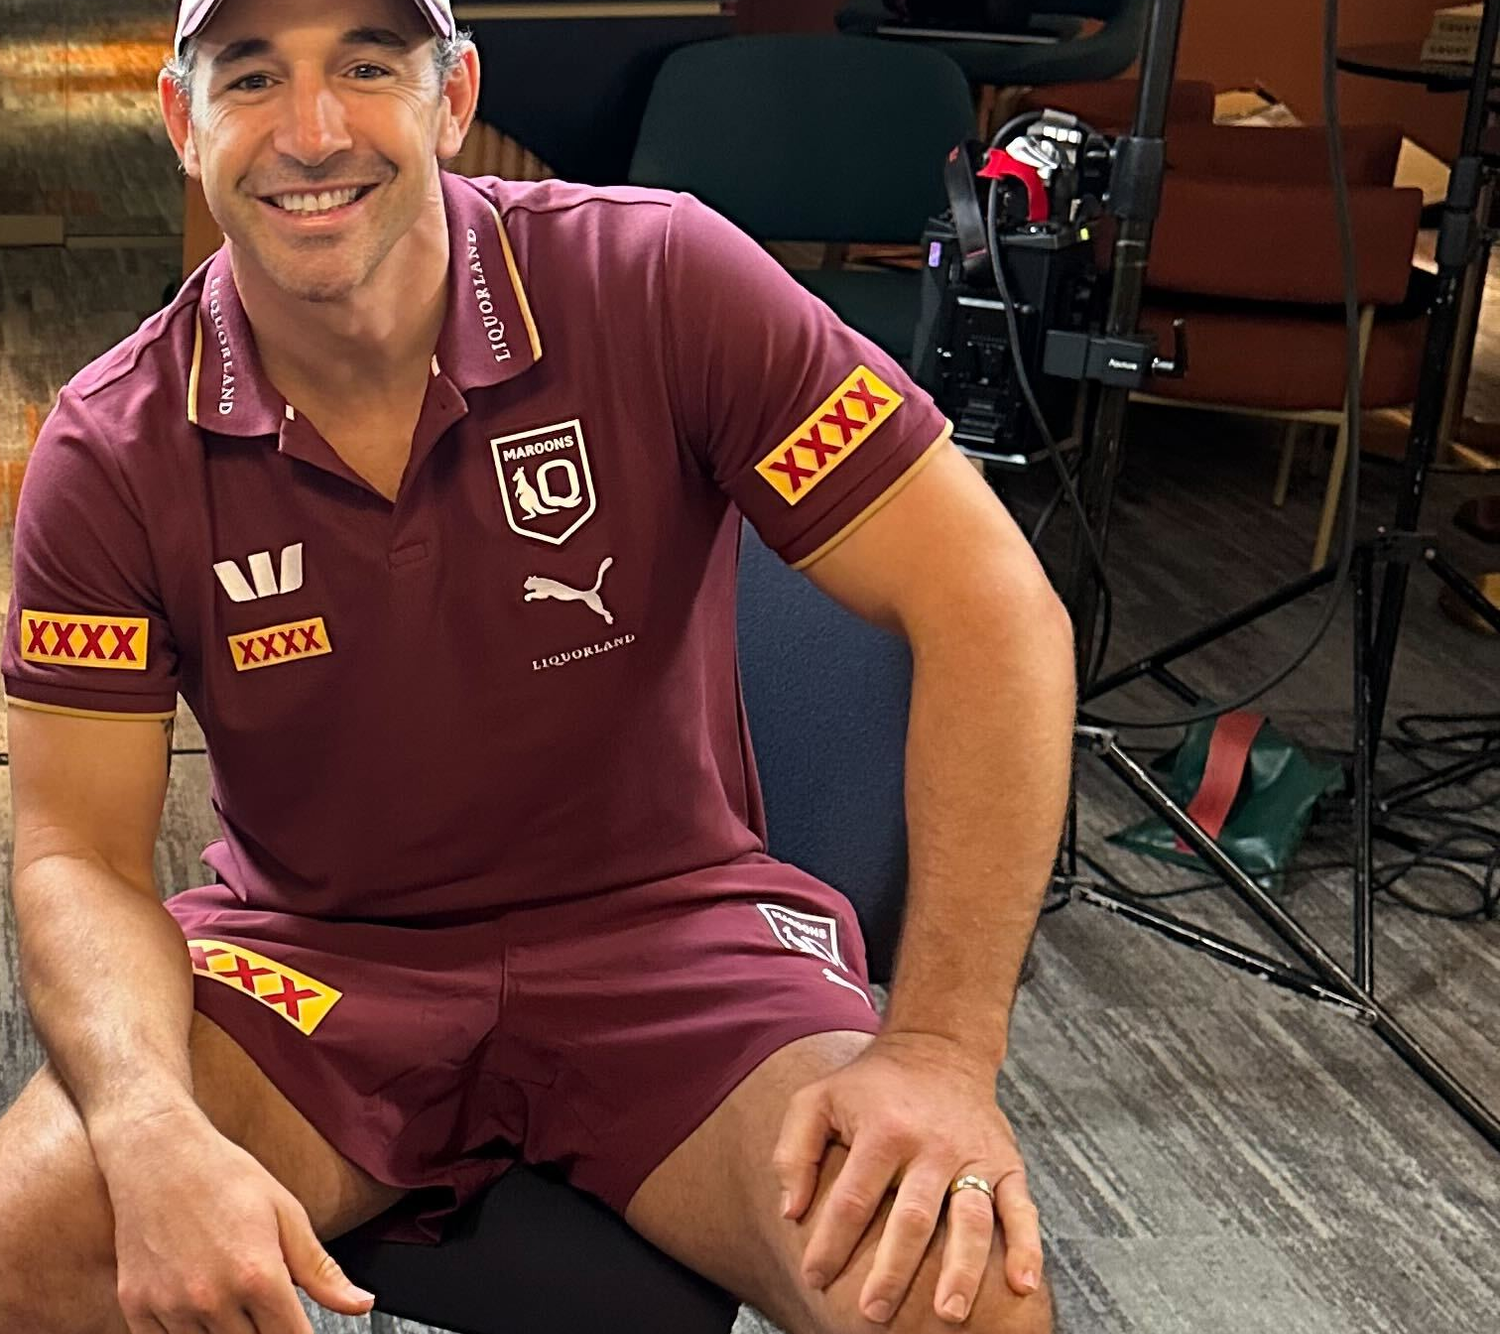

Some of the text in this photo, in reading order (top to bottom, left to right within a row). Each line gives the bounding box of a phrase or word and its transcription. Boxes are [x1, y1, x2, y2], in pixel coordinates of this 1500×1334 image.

[466, 228, 512, 363] LIQUORLAND
[209, 276, 236, 415] LIQUORLAND
[502, 435, 575, 462] MAROONS
[768, 377, 890, 493] XXXX
[26, 618, 140, 662] XXXX
[236, 624, 323, 665] XXXX
[532, 633, 636, 671] LIQUORLAND
[189, 945, 323, 1023] XXX
